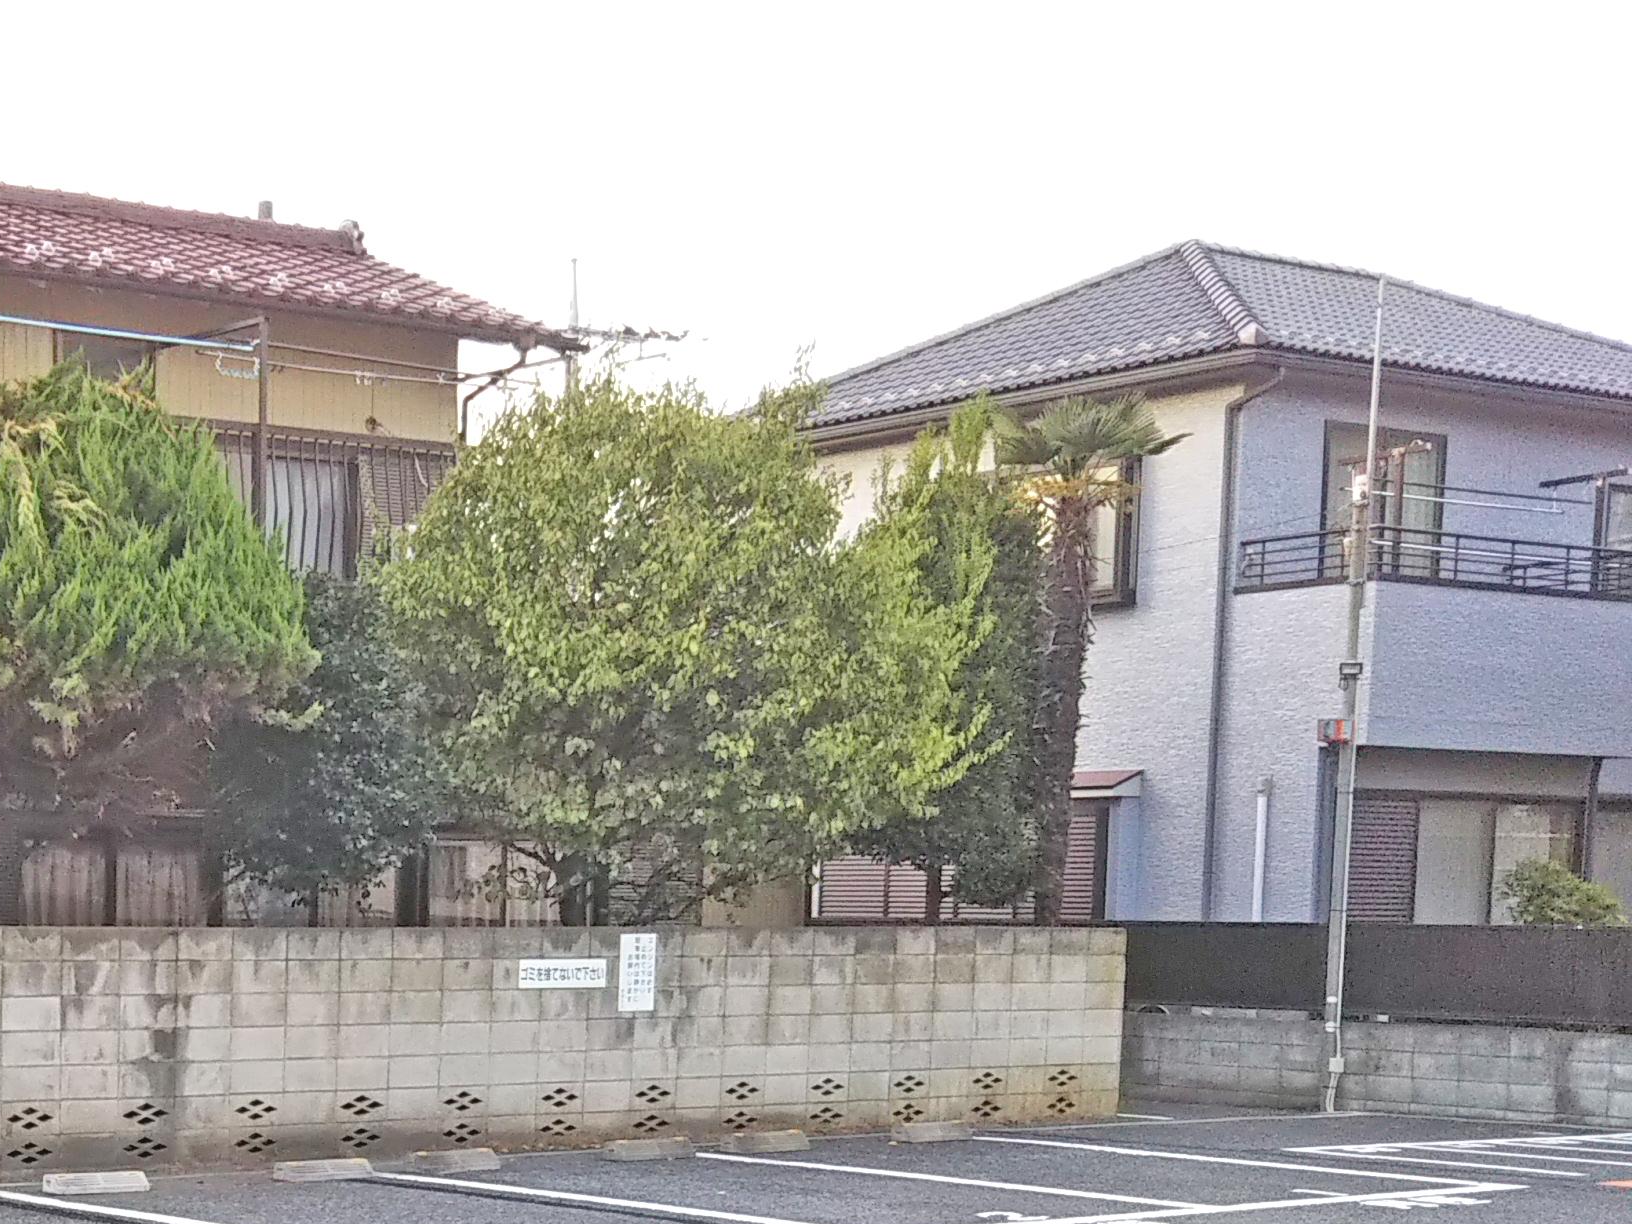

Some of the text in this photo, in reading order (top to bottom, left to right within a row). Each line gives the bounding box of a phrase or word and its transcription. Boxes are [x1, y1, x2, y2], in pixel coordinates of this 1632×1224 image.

[520, 966, 604, 982] ゴミを捨てないで下さい
[976, 1211, 1049, 1221] 2
